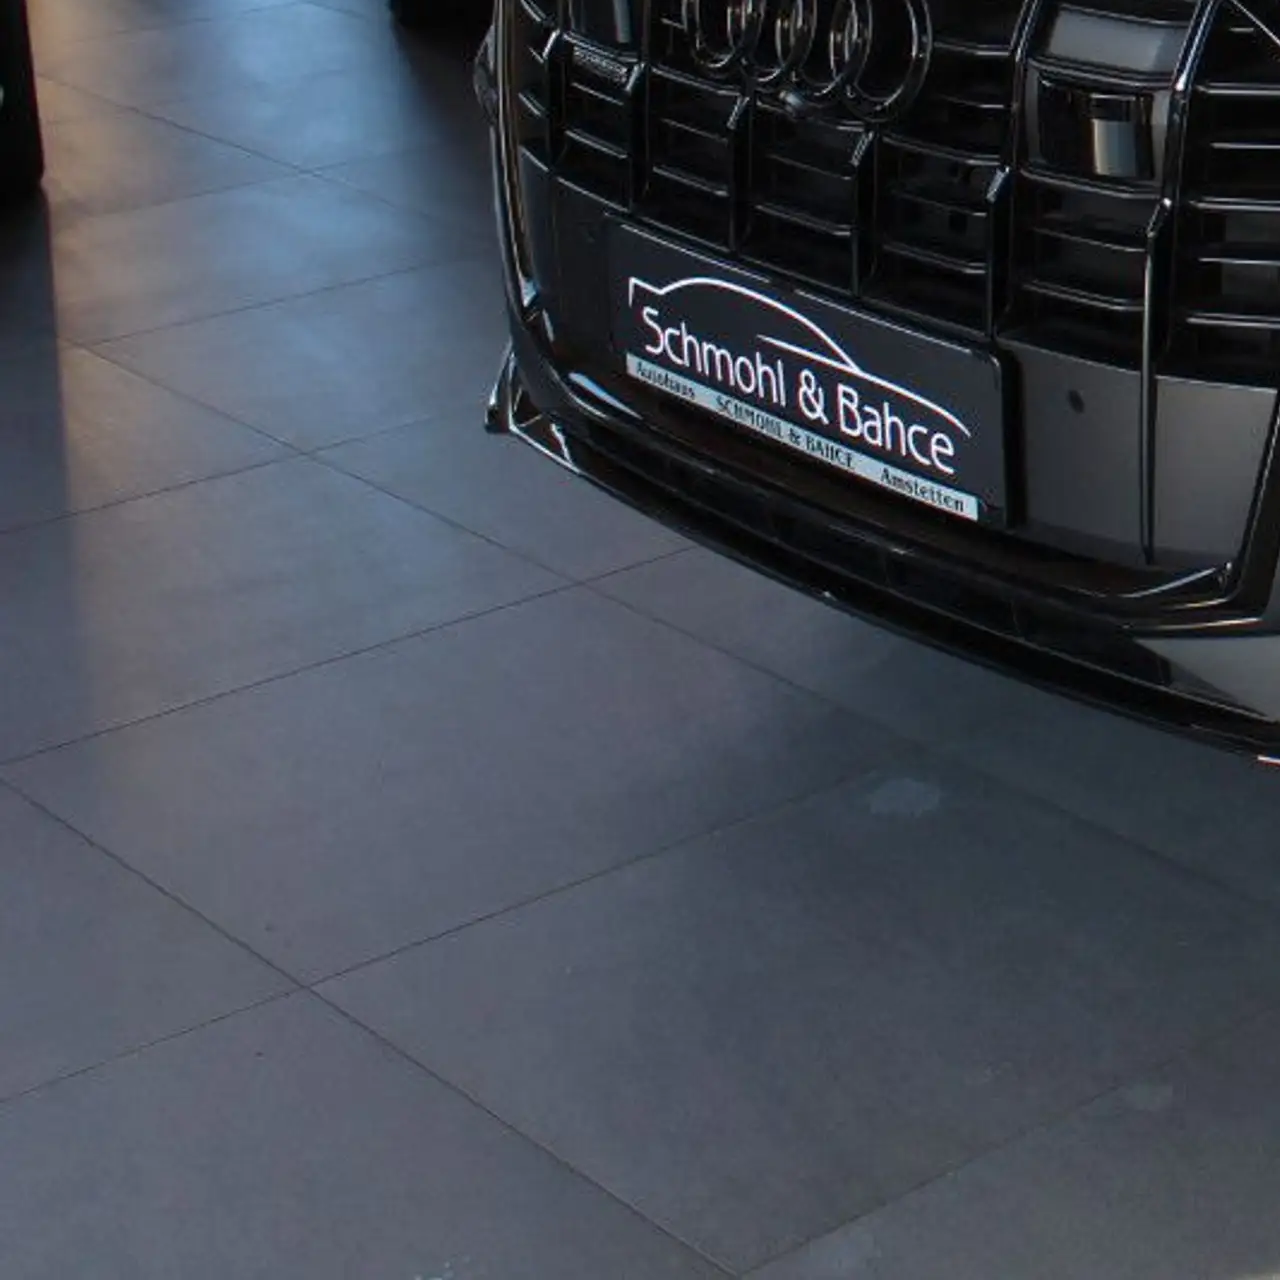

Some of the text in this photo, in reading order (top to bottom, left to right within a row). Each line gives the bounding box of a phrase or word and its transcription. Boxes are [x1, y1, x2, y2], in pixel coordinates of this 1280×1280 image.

[636, 361, 965, 512] Autohaus SCHMOHL & BAHCE Amstetten
[642, 306, 955, 474] Schmohl & Bahce
